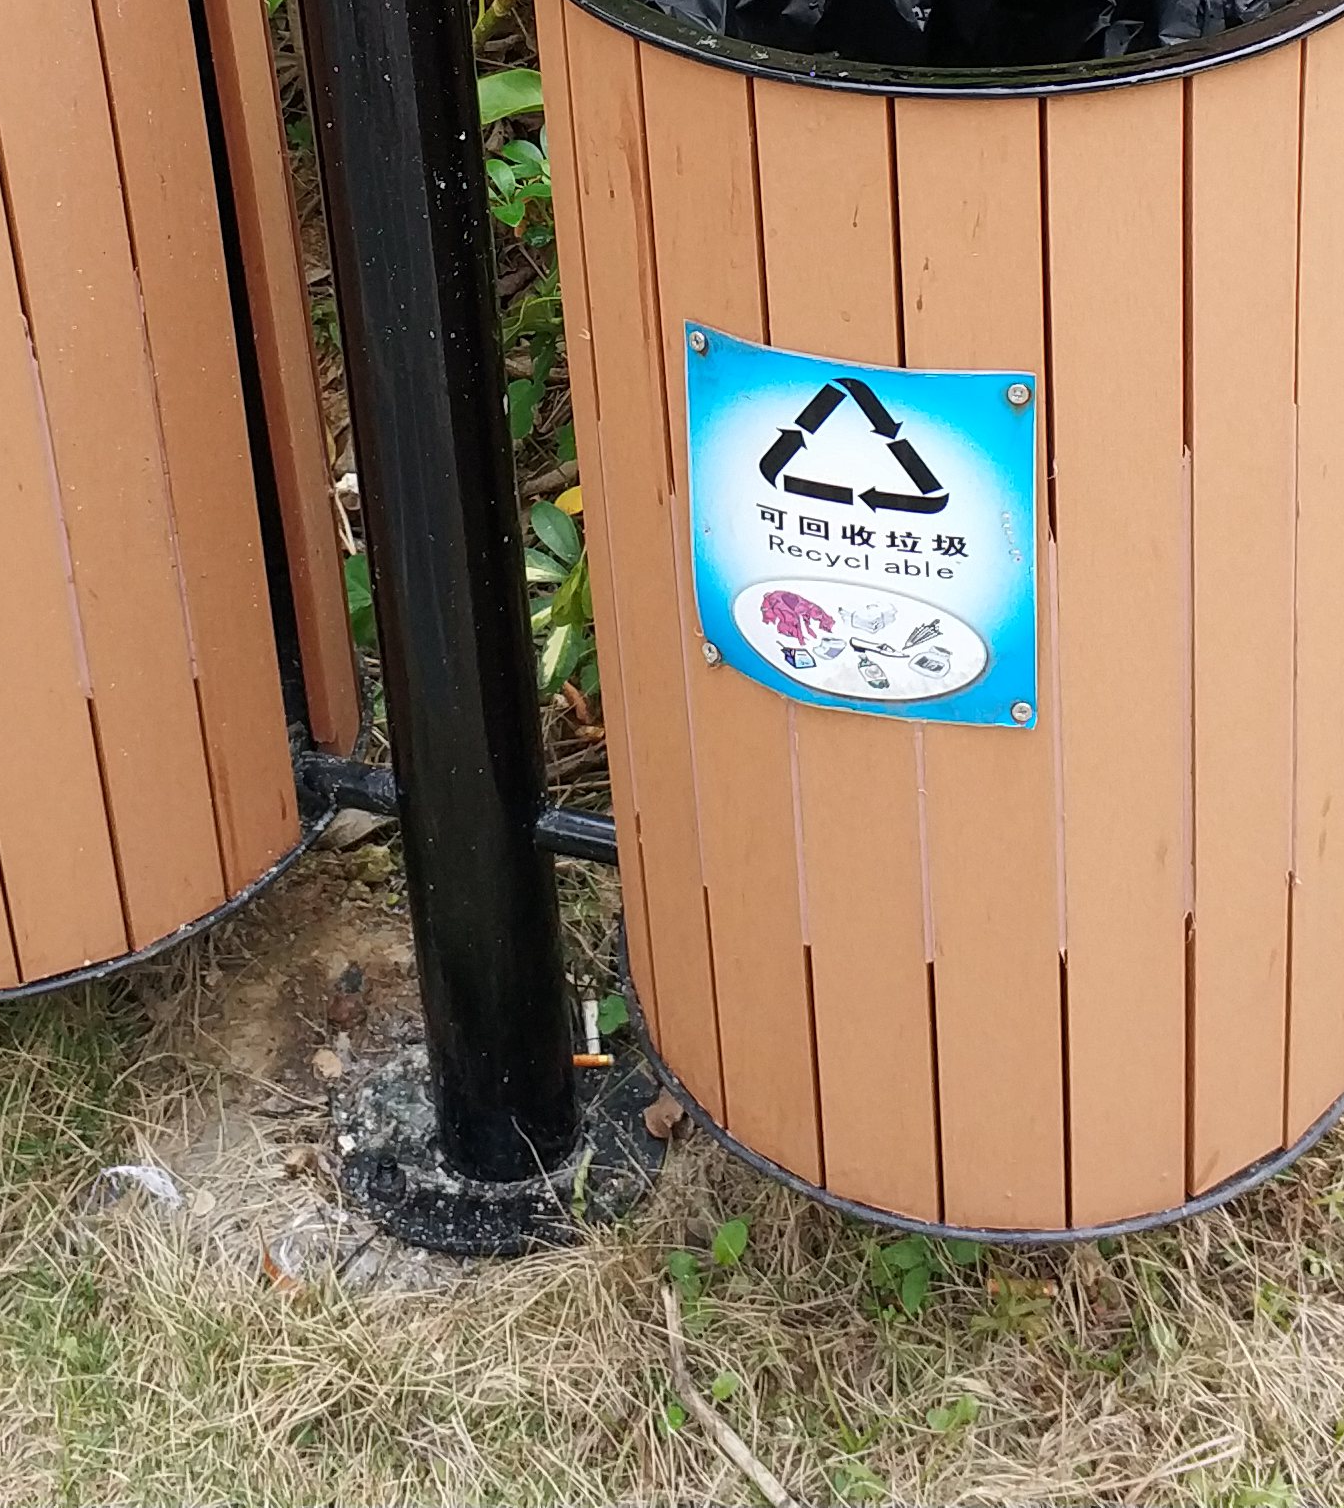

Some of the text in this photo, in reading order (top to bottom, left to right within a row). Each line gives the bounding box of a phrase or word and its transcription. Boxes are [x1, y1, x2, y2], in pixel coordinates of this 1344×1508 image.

[756, 503, 969, 558] 可回收垃圾
